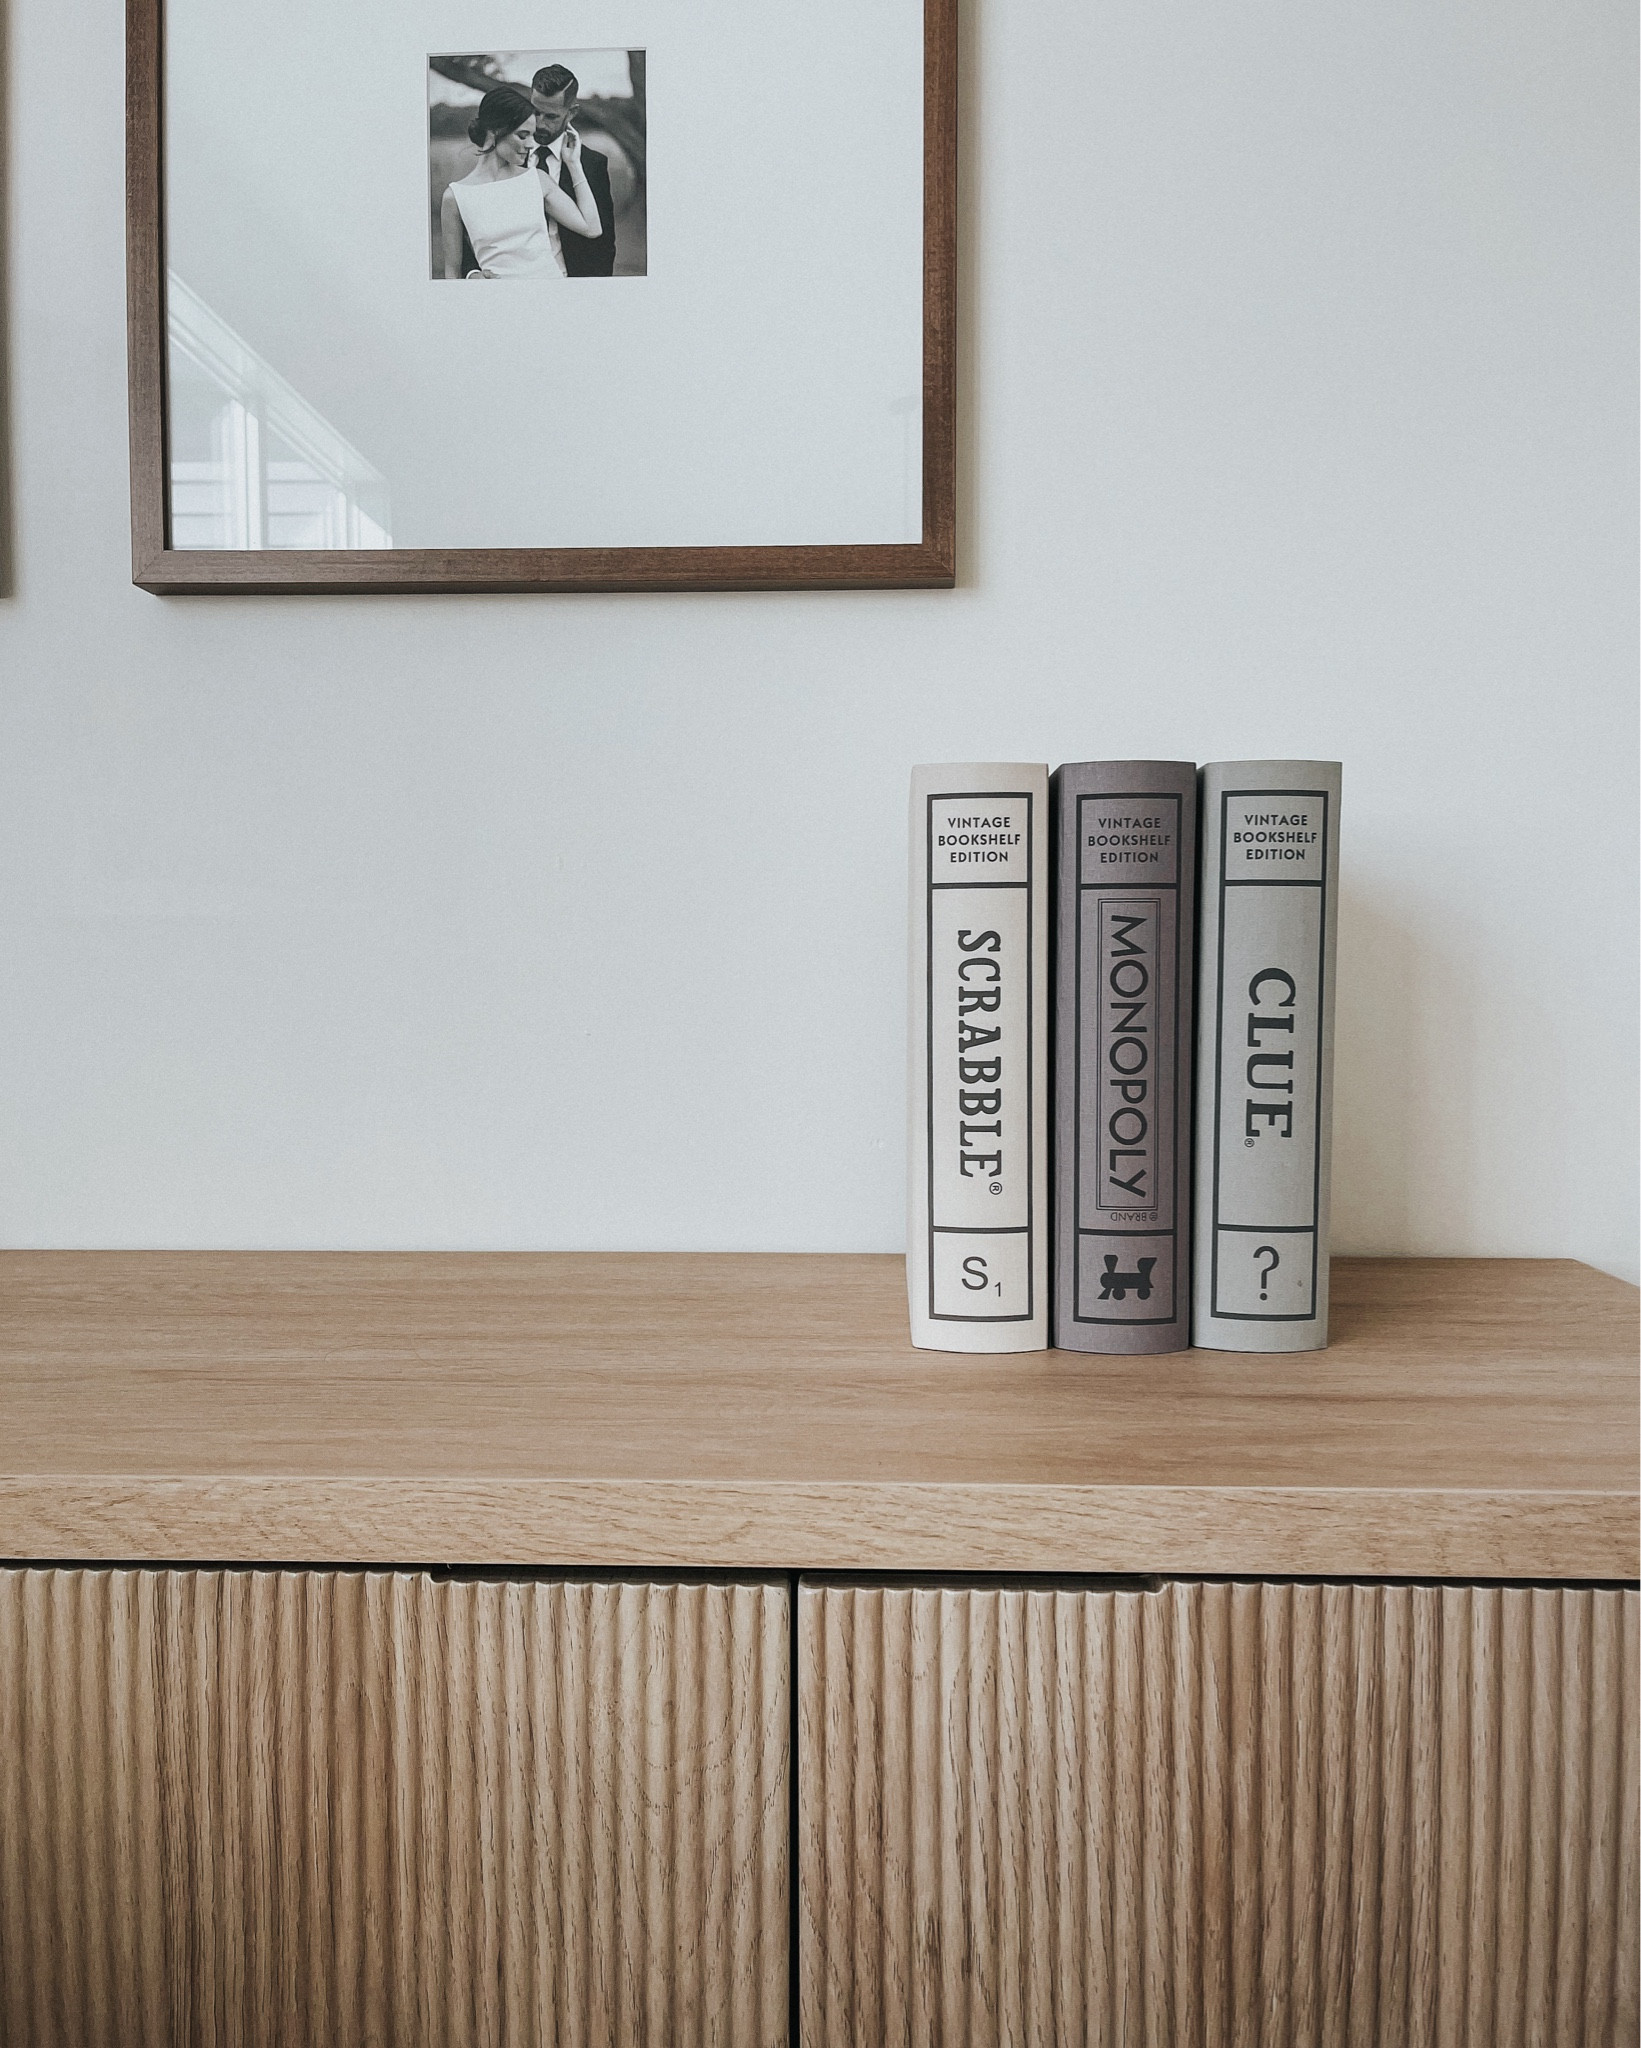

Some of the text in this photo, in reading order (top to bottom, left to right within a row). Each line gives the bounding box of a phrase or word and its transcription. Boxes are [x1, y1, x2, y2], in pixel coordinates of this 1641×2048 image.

[947, 816, 1011, 828] VINTAGE
[1098, 817, 1162, 829] VINTAGE
[1244, 814, 1308, 826] VINTAGE
[938, 833, 1021, 847] BOOKSHELF
[1088, 834, 1171, 847] BOOKSHELF
[1233, 831, 1318, 844] BOOKSHELF
[950, 851, 1009, 863] EDITION
[1100, 851, 1159, 863] EDITION
[1246, 848, 1306, 861] EDITION
[1109, 914, 1149, 1199] MONOPOLY
